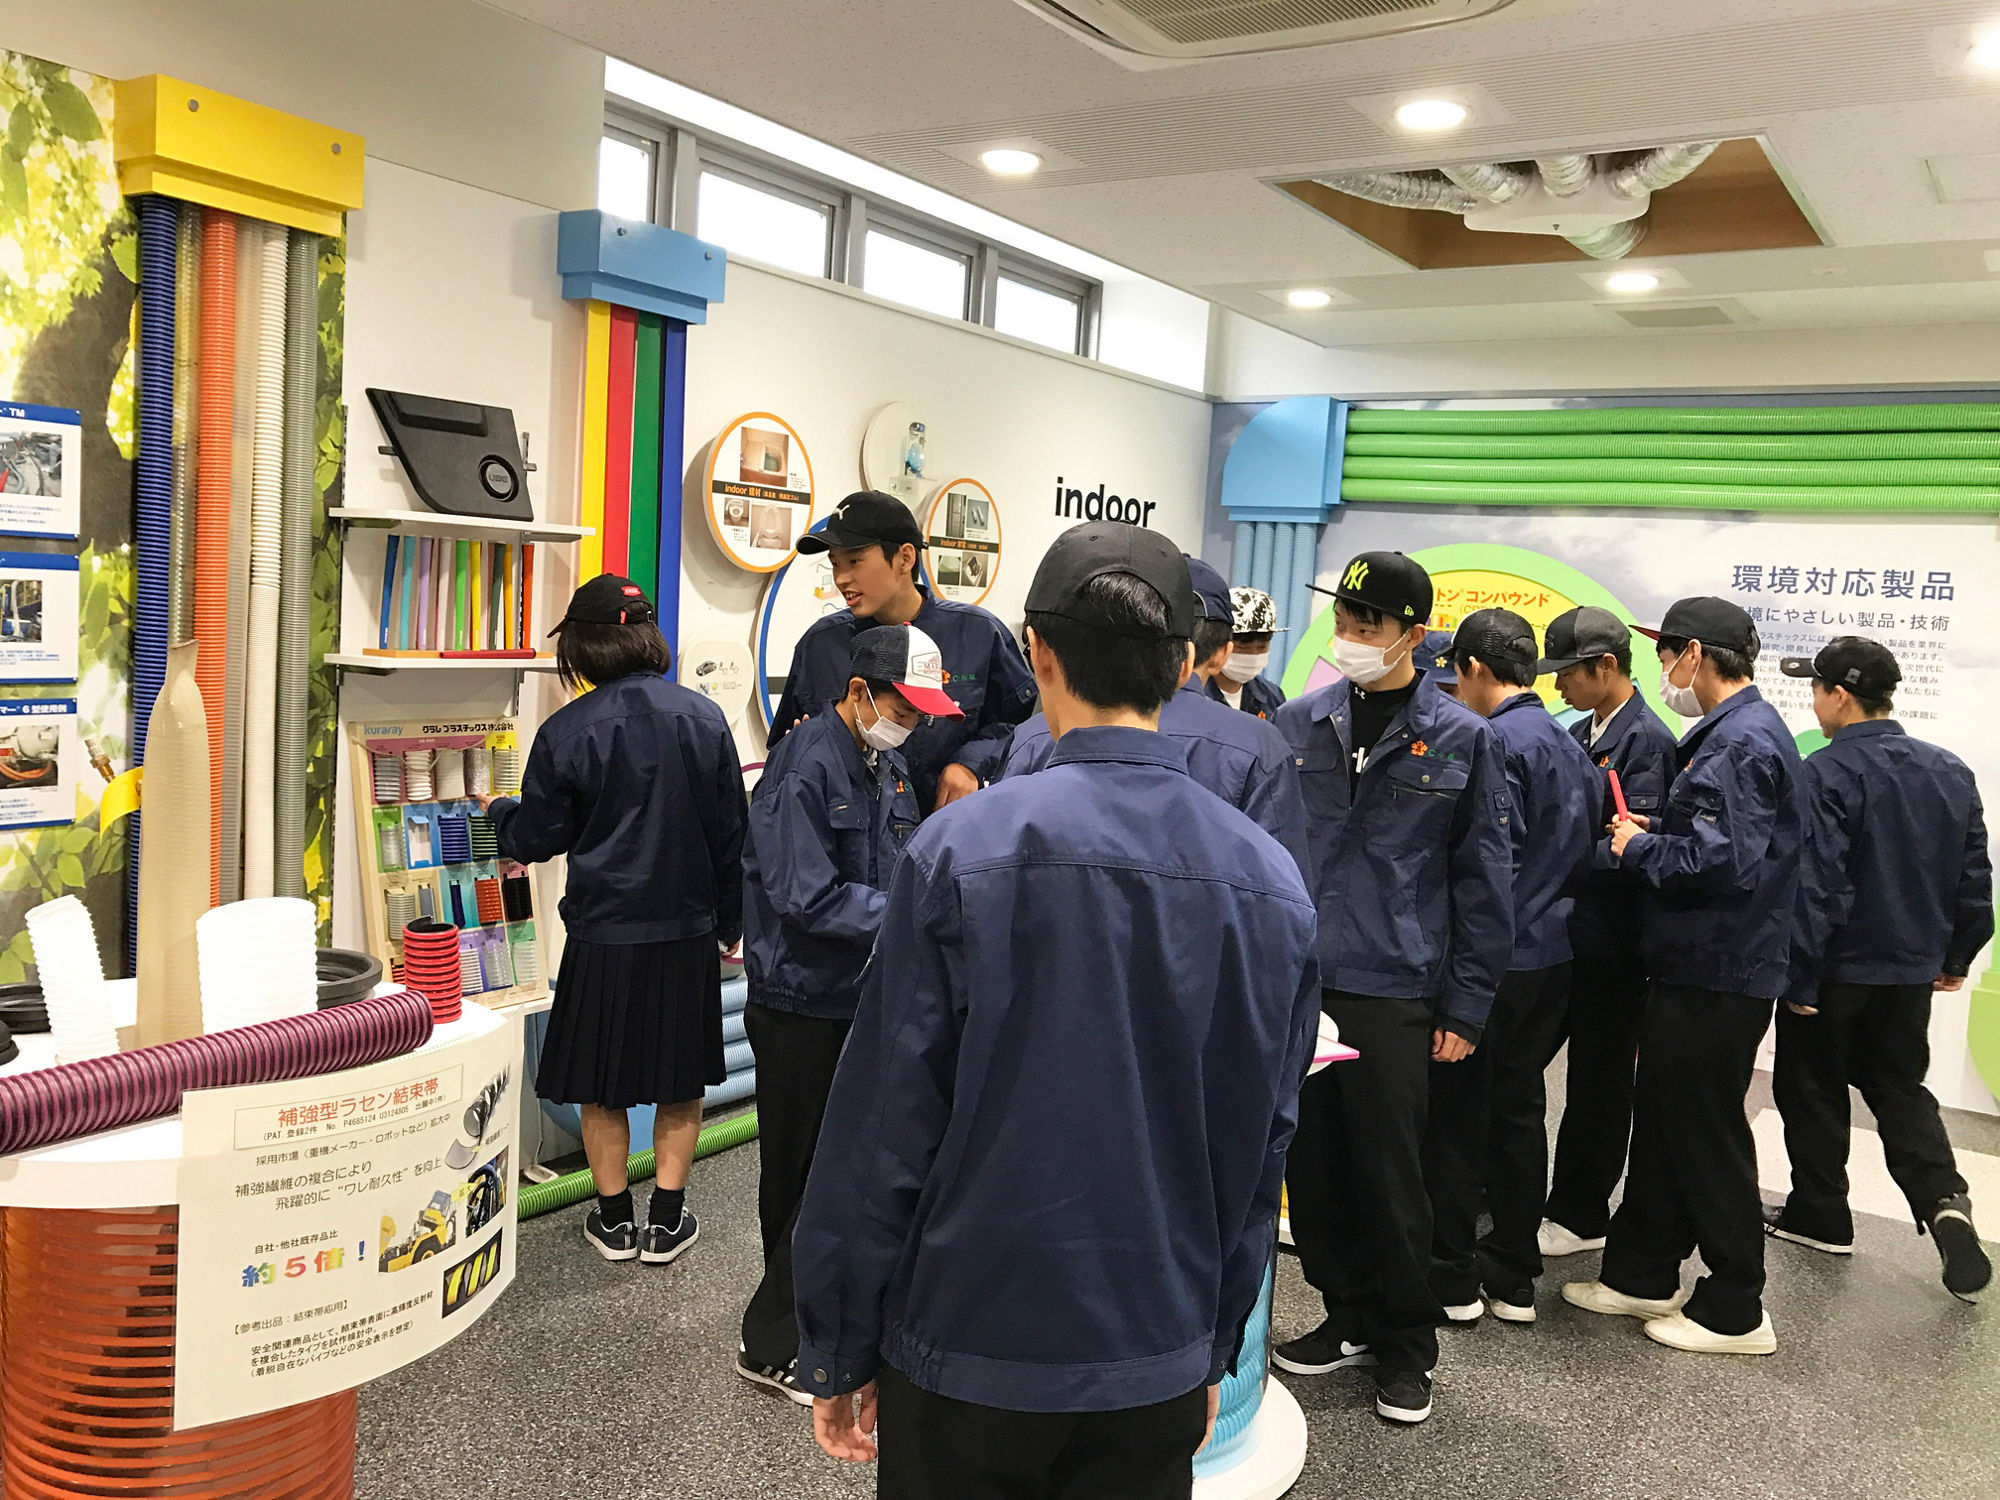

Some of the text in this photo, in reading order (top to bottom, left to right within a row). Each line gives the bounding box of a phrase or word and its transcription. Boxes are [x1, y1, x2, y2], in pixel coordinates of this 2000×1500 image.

[1055, 476, 1157, 528] indoor
[1466, 590, 1551, 607] コンパウンド
[1731, 565, 1955, 601] 環境対応製品
[1741, 606, 1950, 631] 境にやさしい製品・技術
[364, 725, 403, 736] kuraray
[278, 1077, 439, 1128] 補強型ラセン結束帯
[235, 1160, 372, 1198] 補強繊維の複合により
